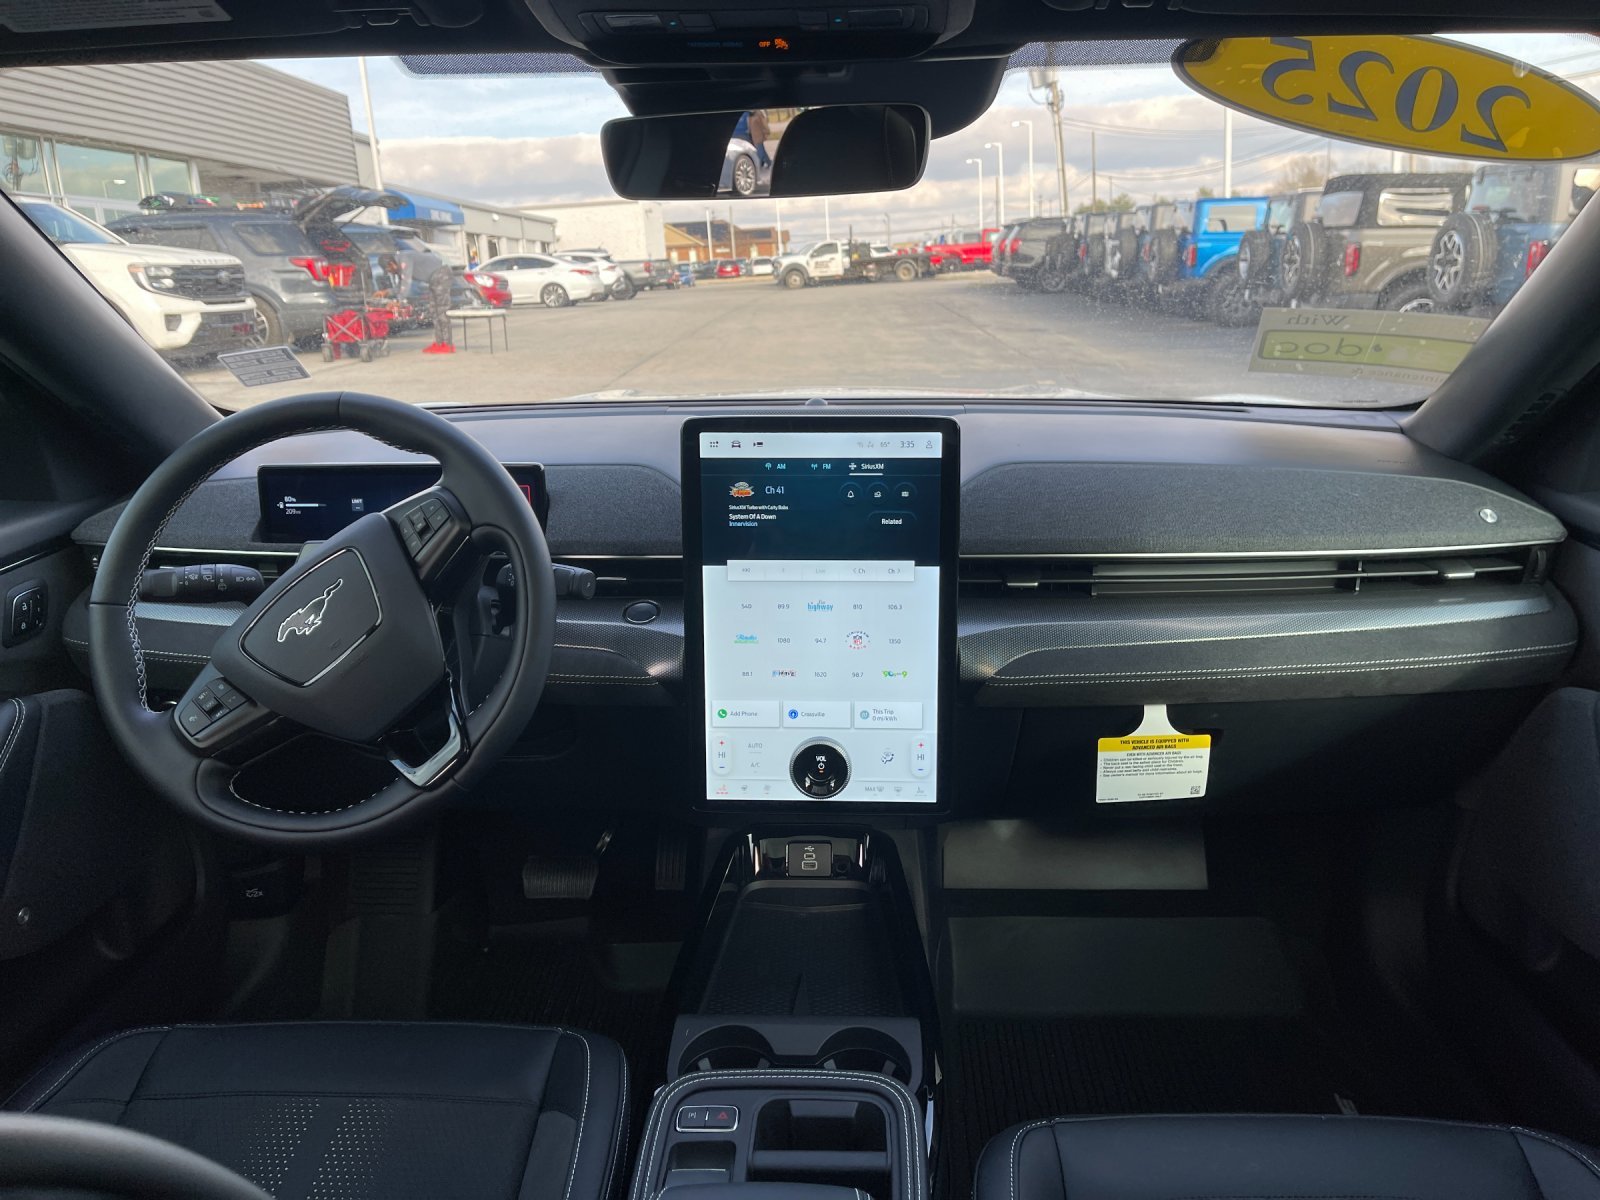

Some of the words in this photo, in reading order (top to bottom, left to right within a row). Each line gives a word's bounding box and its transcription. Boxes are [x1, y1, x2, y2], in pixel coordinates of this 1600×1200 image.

[899, 440, 915, 448] 3:35
[765, 485, 775, 495] Ch
[775, 485, 785, 495] 41
[728, 513, 749, 521] System
[807, 601, 834, 612] highway
